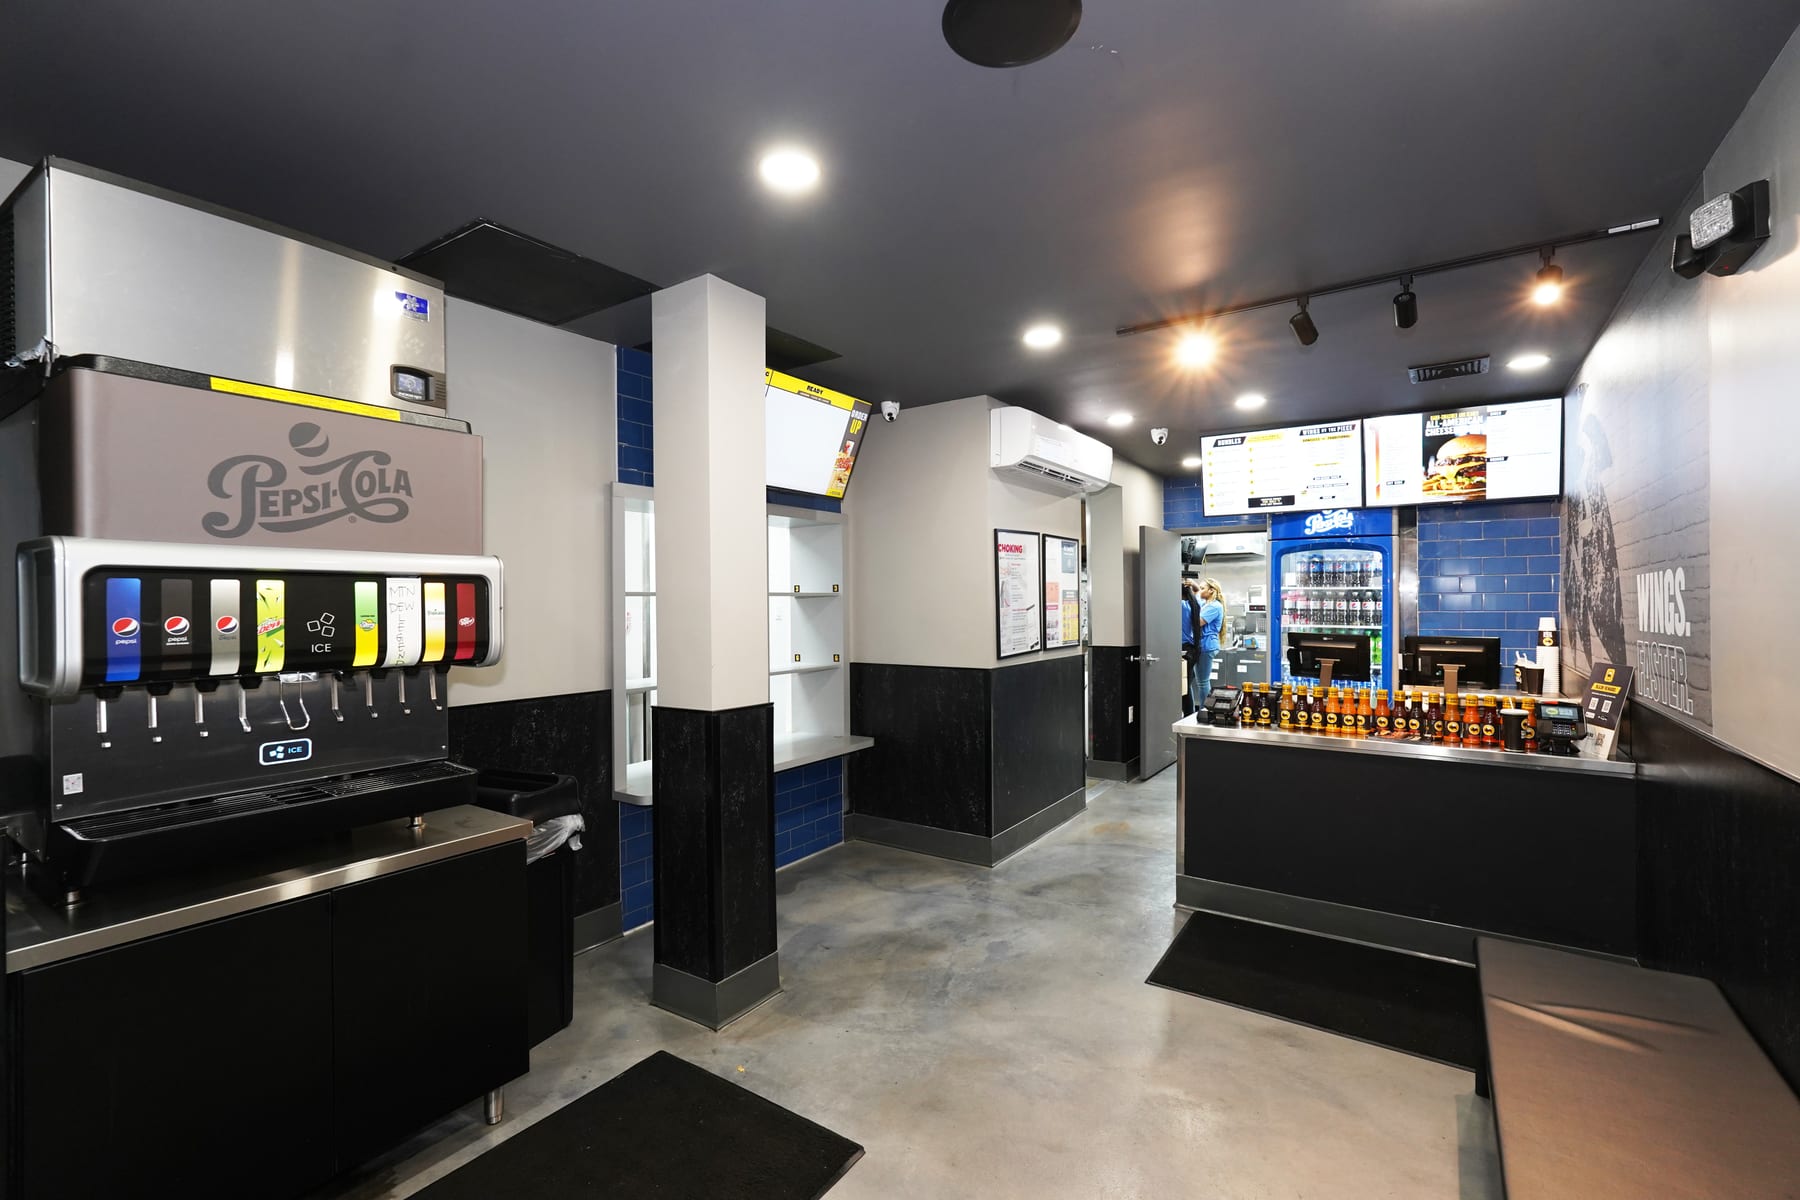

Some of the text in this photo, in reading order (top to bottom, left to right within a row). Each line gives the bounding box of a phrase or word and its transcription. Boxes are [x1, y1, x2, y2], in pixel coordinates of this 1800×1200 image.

[807, 386, 823, 395] READY
[850, 419, 862, 434] UP
[997, 543, 1023, 554] CHOKING
[1636, 566, 1691, 637] WINGS.
[388, 601, 415, 614] DEW
[115, 637, 137, 646] pepsi
[311, 643, 332, 653] ICE
[287, 745, 303, 755] ICE
